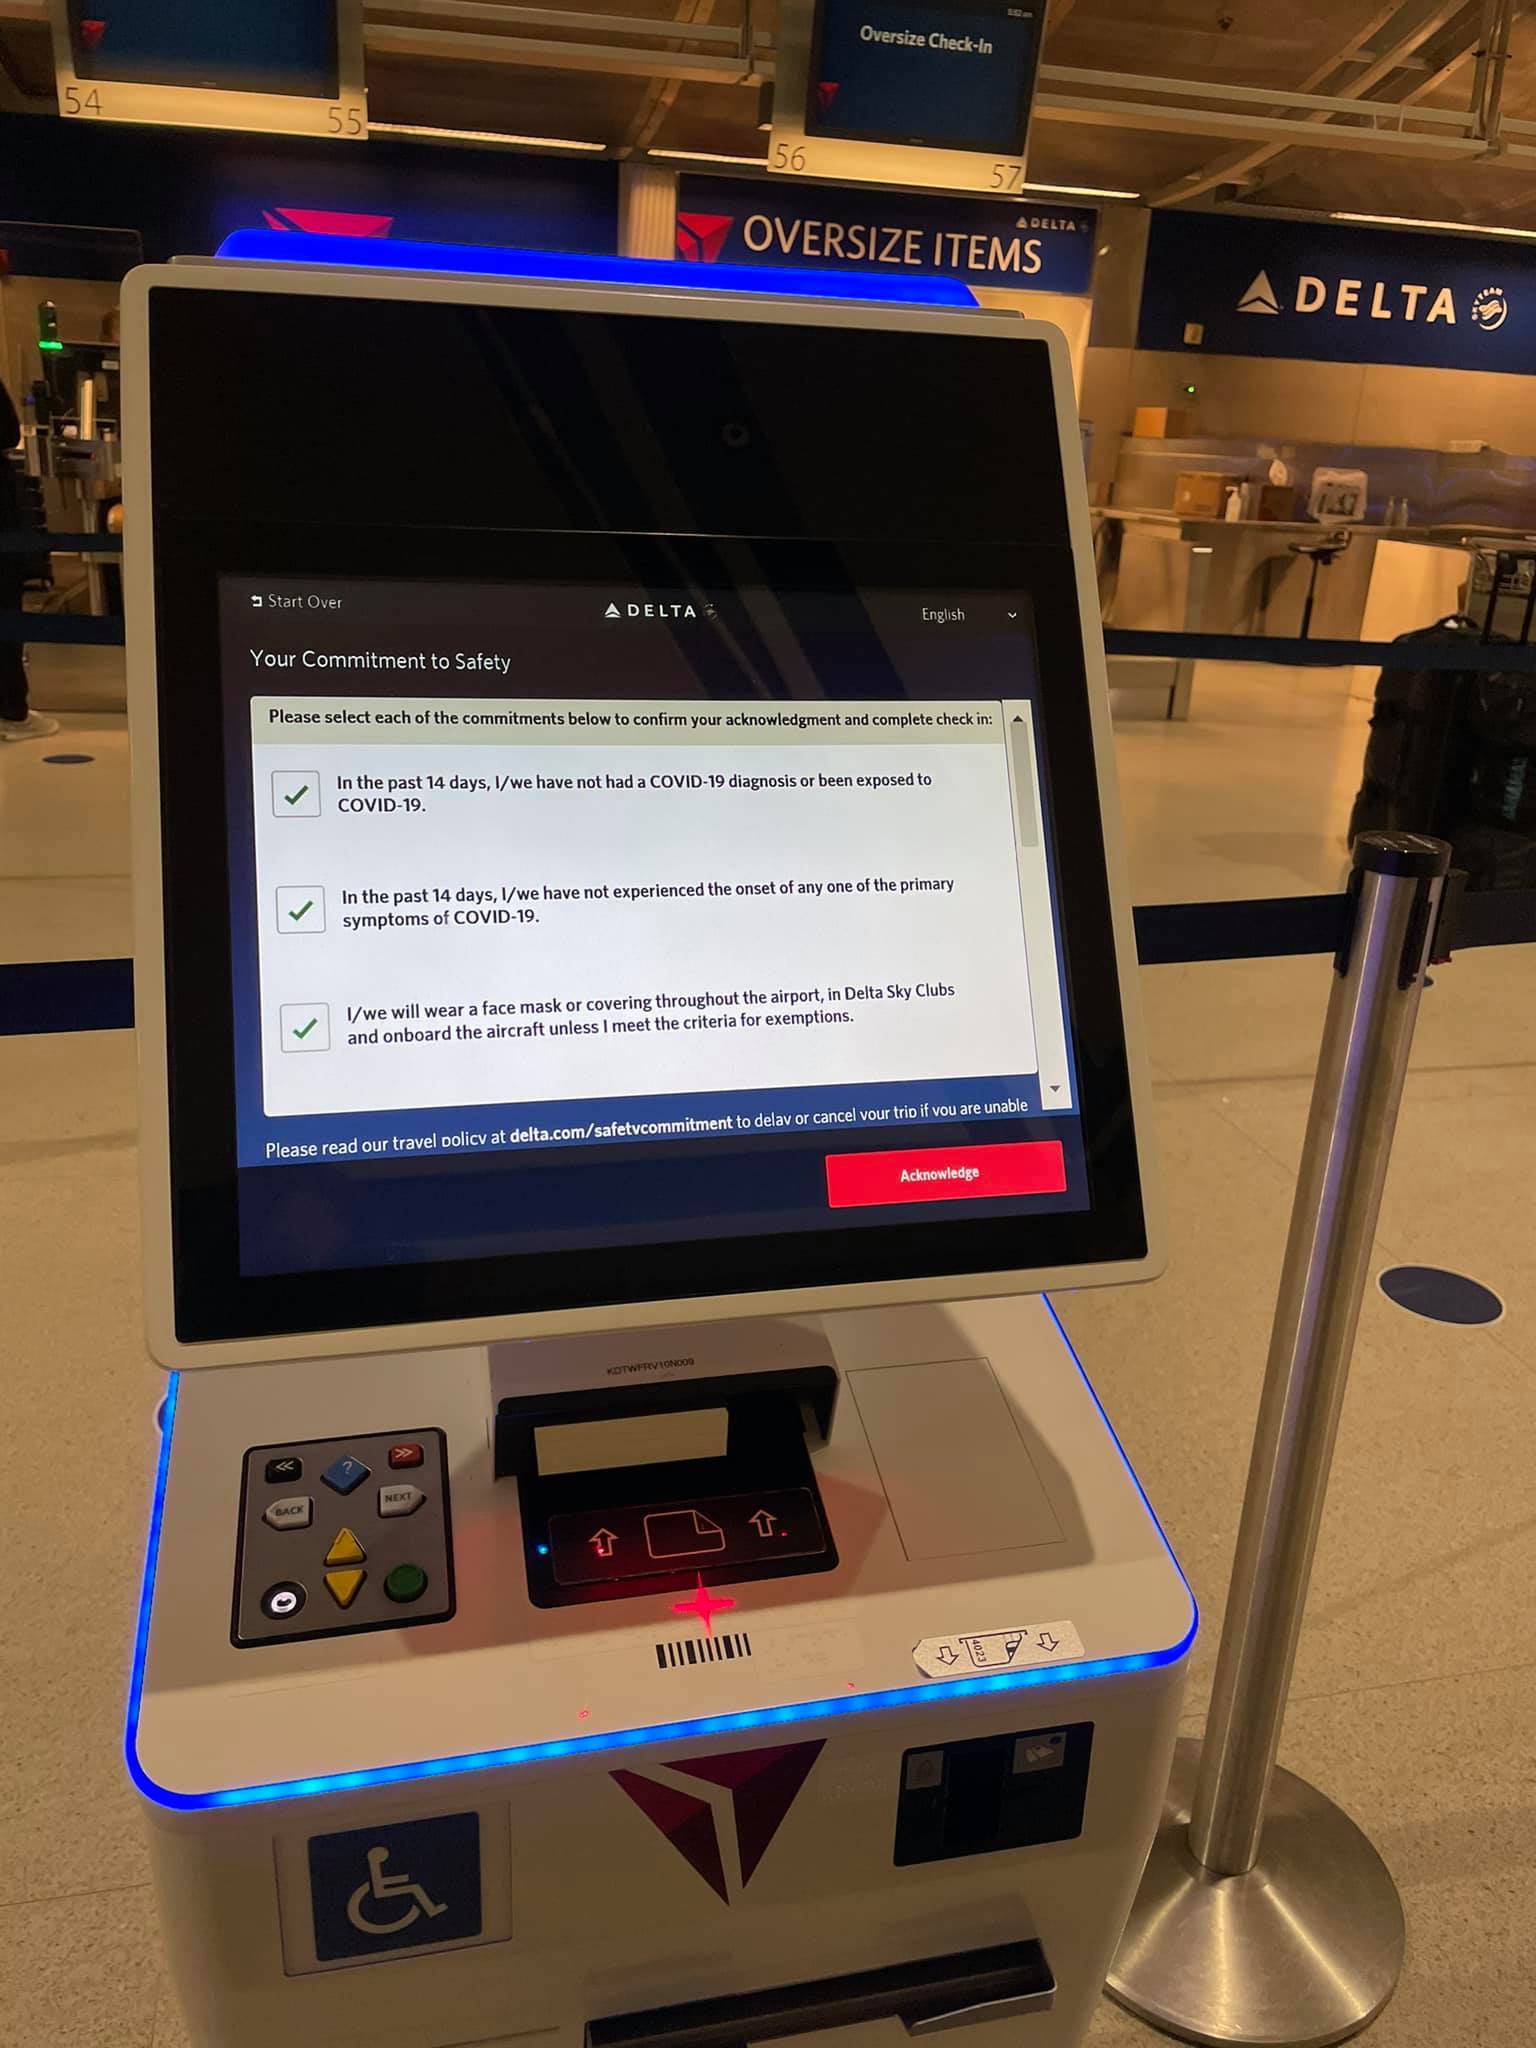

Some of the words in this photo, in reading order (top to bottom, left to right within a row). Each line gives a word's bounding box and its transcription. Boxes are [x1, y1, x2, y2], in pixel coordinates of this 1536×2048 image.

[859, 24, 926, 47] Oversize
[927, 32, 993, 55] Check-In
[65, 86, 103, 116] 54
[327, 106, 362, 135] 55
[774, 143, 807, 172] 56
[989, 164, 1022, 191] 57
[1030, 218, 1078, 232] DELTA
[743, 214, 925, 265] OVERSIZE
[934, 232, 1043, 275] ITEMS
[1294, 275, 1457, 325] DELTA
[268, 593, 304, 609] Start
[307, 594, 343, 609] Over
[627, 604, 697, 619] DELTA
[922, 607, 966, 624] English
[249, 648, 297, 668] Your
[302, 650, 427, 670] Commitment
[430, 652, 450, 670] to
[455, 652, 511, 675] Safety
[269, 708, 321, 724] Please
[324, 709, 372, 724] select
[374, 709, 412, 725] each
[414, 709, 431, 725] of
[433, 710, 459, 725] the
[462, 710, 565, 726] commitments
[567, 711, 612, 726] below
[614, 712, 630, 726] to
[632, 711, 688, 726] confirm
[690, 715, 723, 729] your
[725, 711, 842, 729] acknowledgment
[844, 713, 870, 726] and
[872, 711, 934, 729] complete
[936, 711, 974, 726] check
[976, 711, 993, 725] in:
[337, 775, 353, 790] In
[356, 774, 384, 790] the
[387, 775, 423, 793] past
[426, 775, 446, 790] 14
[449, 774, 491, 793] days,
[495, 775, 533, 792] I/we
[536, 774, 574, 790] have
[576, 775, 603, 789] not
[605, 773, 634, 789] had
[637, 778, 647, 789] a
[649, 774, 725, 789] COVID-19
[728, 773, 798, 792] diagnosis
[799, 776, 816, 788] or
[818, 772, 854, 788] been
[856, 771, 915, 790] exposed
[916, 772, 932, 786] to
[337, 797, 426, 813] COVID-19.
[342, 889, 358, 905] In
[361, 888, 390, 905] the
[393, 888, 429, 908] past
[432, 888, 452, 903] 14
[455, 886, 498, 906] days,
[501, 886, 540, 904] I/we
[543, 884, 581, 901] have
[583, 884, 610, 900] not
[612, 881, 705, 902] experienced
[707, 881, 732, 897] the
[735, 881, 777, 896] onset
[779, 879, 794, 895] of
[797, 882, 824, 897] any
[826, 882, 854, 894] one
[856, 877, 871, 893] of
[873, 877, 897, 892] the
[900, 877, 954, 895] primary
[343, 912, 430, 932] symptoms
[433, 909, 450, 926] of
[453, 908, 540, 925] COVID-19.
[347, 1005, 388, 1025] I/we
[390, 1002, 420, 1020] will
[423, 1005, 465, 1019] wear
[468, 1005, 478, 1017] a
[481, 1000, 516, 1016] face
[519, 997, 563, 1015] mask
[565, 1000, 583, 1013] or
[586, 995, 653, 1013] covering
[654, 991, 740, 1011] throughout
[742, 989, 768, 1005] the
[770, 988, 825, 1007] airport,
[827, 987, 842, 1001] in
[844, 984, 884, 1001] Delta
[886, 983, 912, 1001] Sky
[915, 981, 956, 998] Clubs
[347, 1028, 379, 1046] and
[382, 1024, 452, 1044] onboard
[455, 1024, 483, 1041] the
[486, 1021, 546, 1039] aircraft
[549, 1019, 600, 1036] unless
[603, 1018, 608, 1034] I
[611, 1017, 652, 1033] meet
[653, 1015, 680, 1031] the
[682, 1013, 737, 1030] criteria
[740, 1012, 762, 1028] for
[765, 1009, 854, 1028] exemptions.
[266, 1141, 318, 1159] Please
[322, 1137, 358, 1156] read
[361, 1139, 389, 1153] our
[392, 1132, 437, 1151] travel
[490, 1129, 507, 1145] at
[735, 1114, 752, 1129] to
[794, 1113, 810, 1126] or
[812, 1106, 857, 1125] cancel
[919, 1102, 929, 1118] if
[959, 1103, 982, 1116] are
[983, 1097, 1029, 1114] unable
[900, 1166, 980, 1183] Acknowledge
[275, 1504, 305, 1517] BACK
[384, 1491, 413, 1504] NEXT
